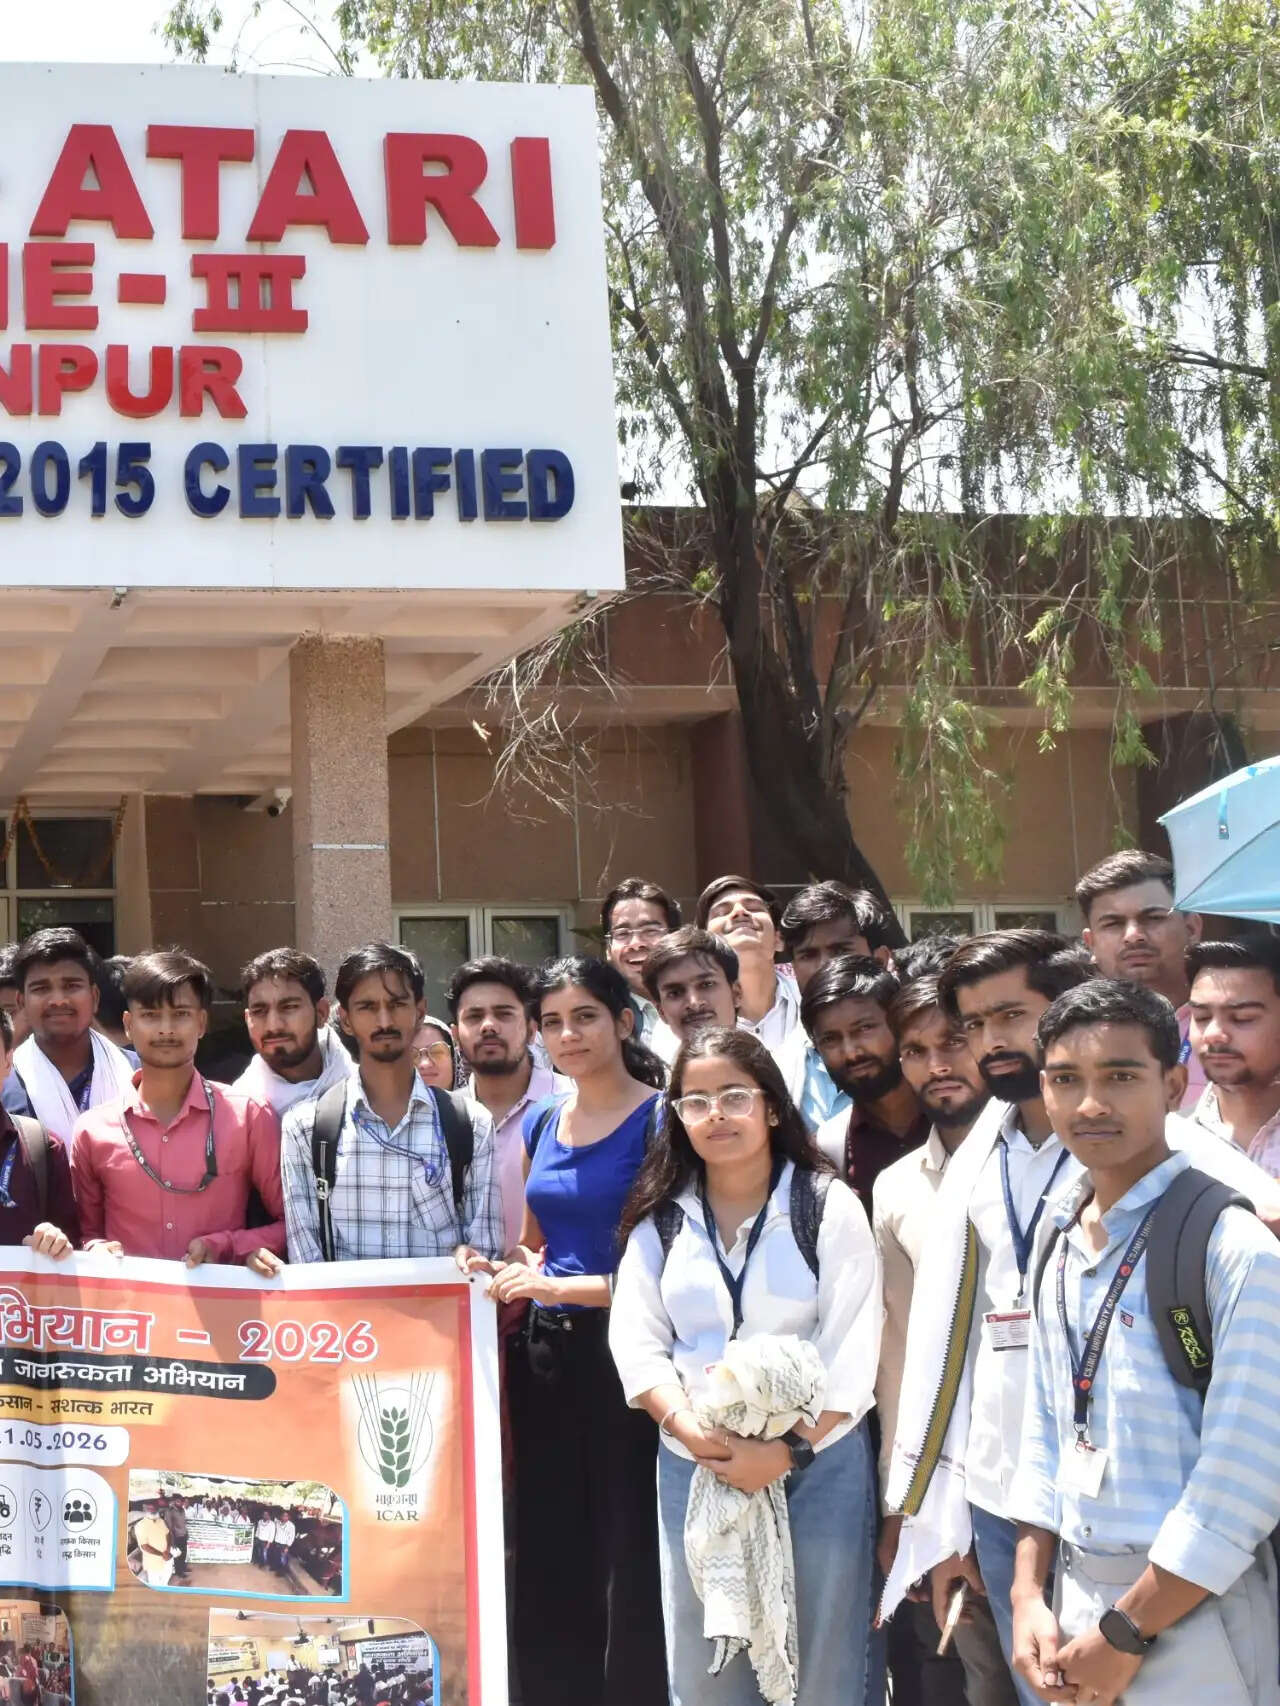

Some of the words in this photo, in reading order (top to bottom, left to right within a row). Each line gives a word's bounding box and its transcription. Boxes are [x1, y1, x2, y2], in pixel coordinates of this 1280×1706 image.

[184, 442, 576, 519] CERTIFIED
[238, 1320, 378, 1363] 2026
[1090, 1309, 1110, 1352] UNIVERSITY
[143, 1362, 247, 1391] अभियान
[110, 1401, 154, 1415] भारत
[376, 1509, 420, 1521] ICAR
